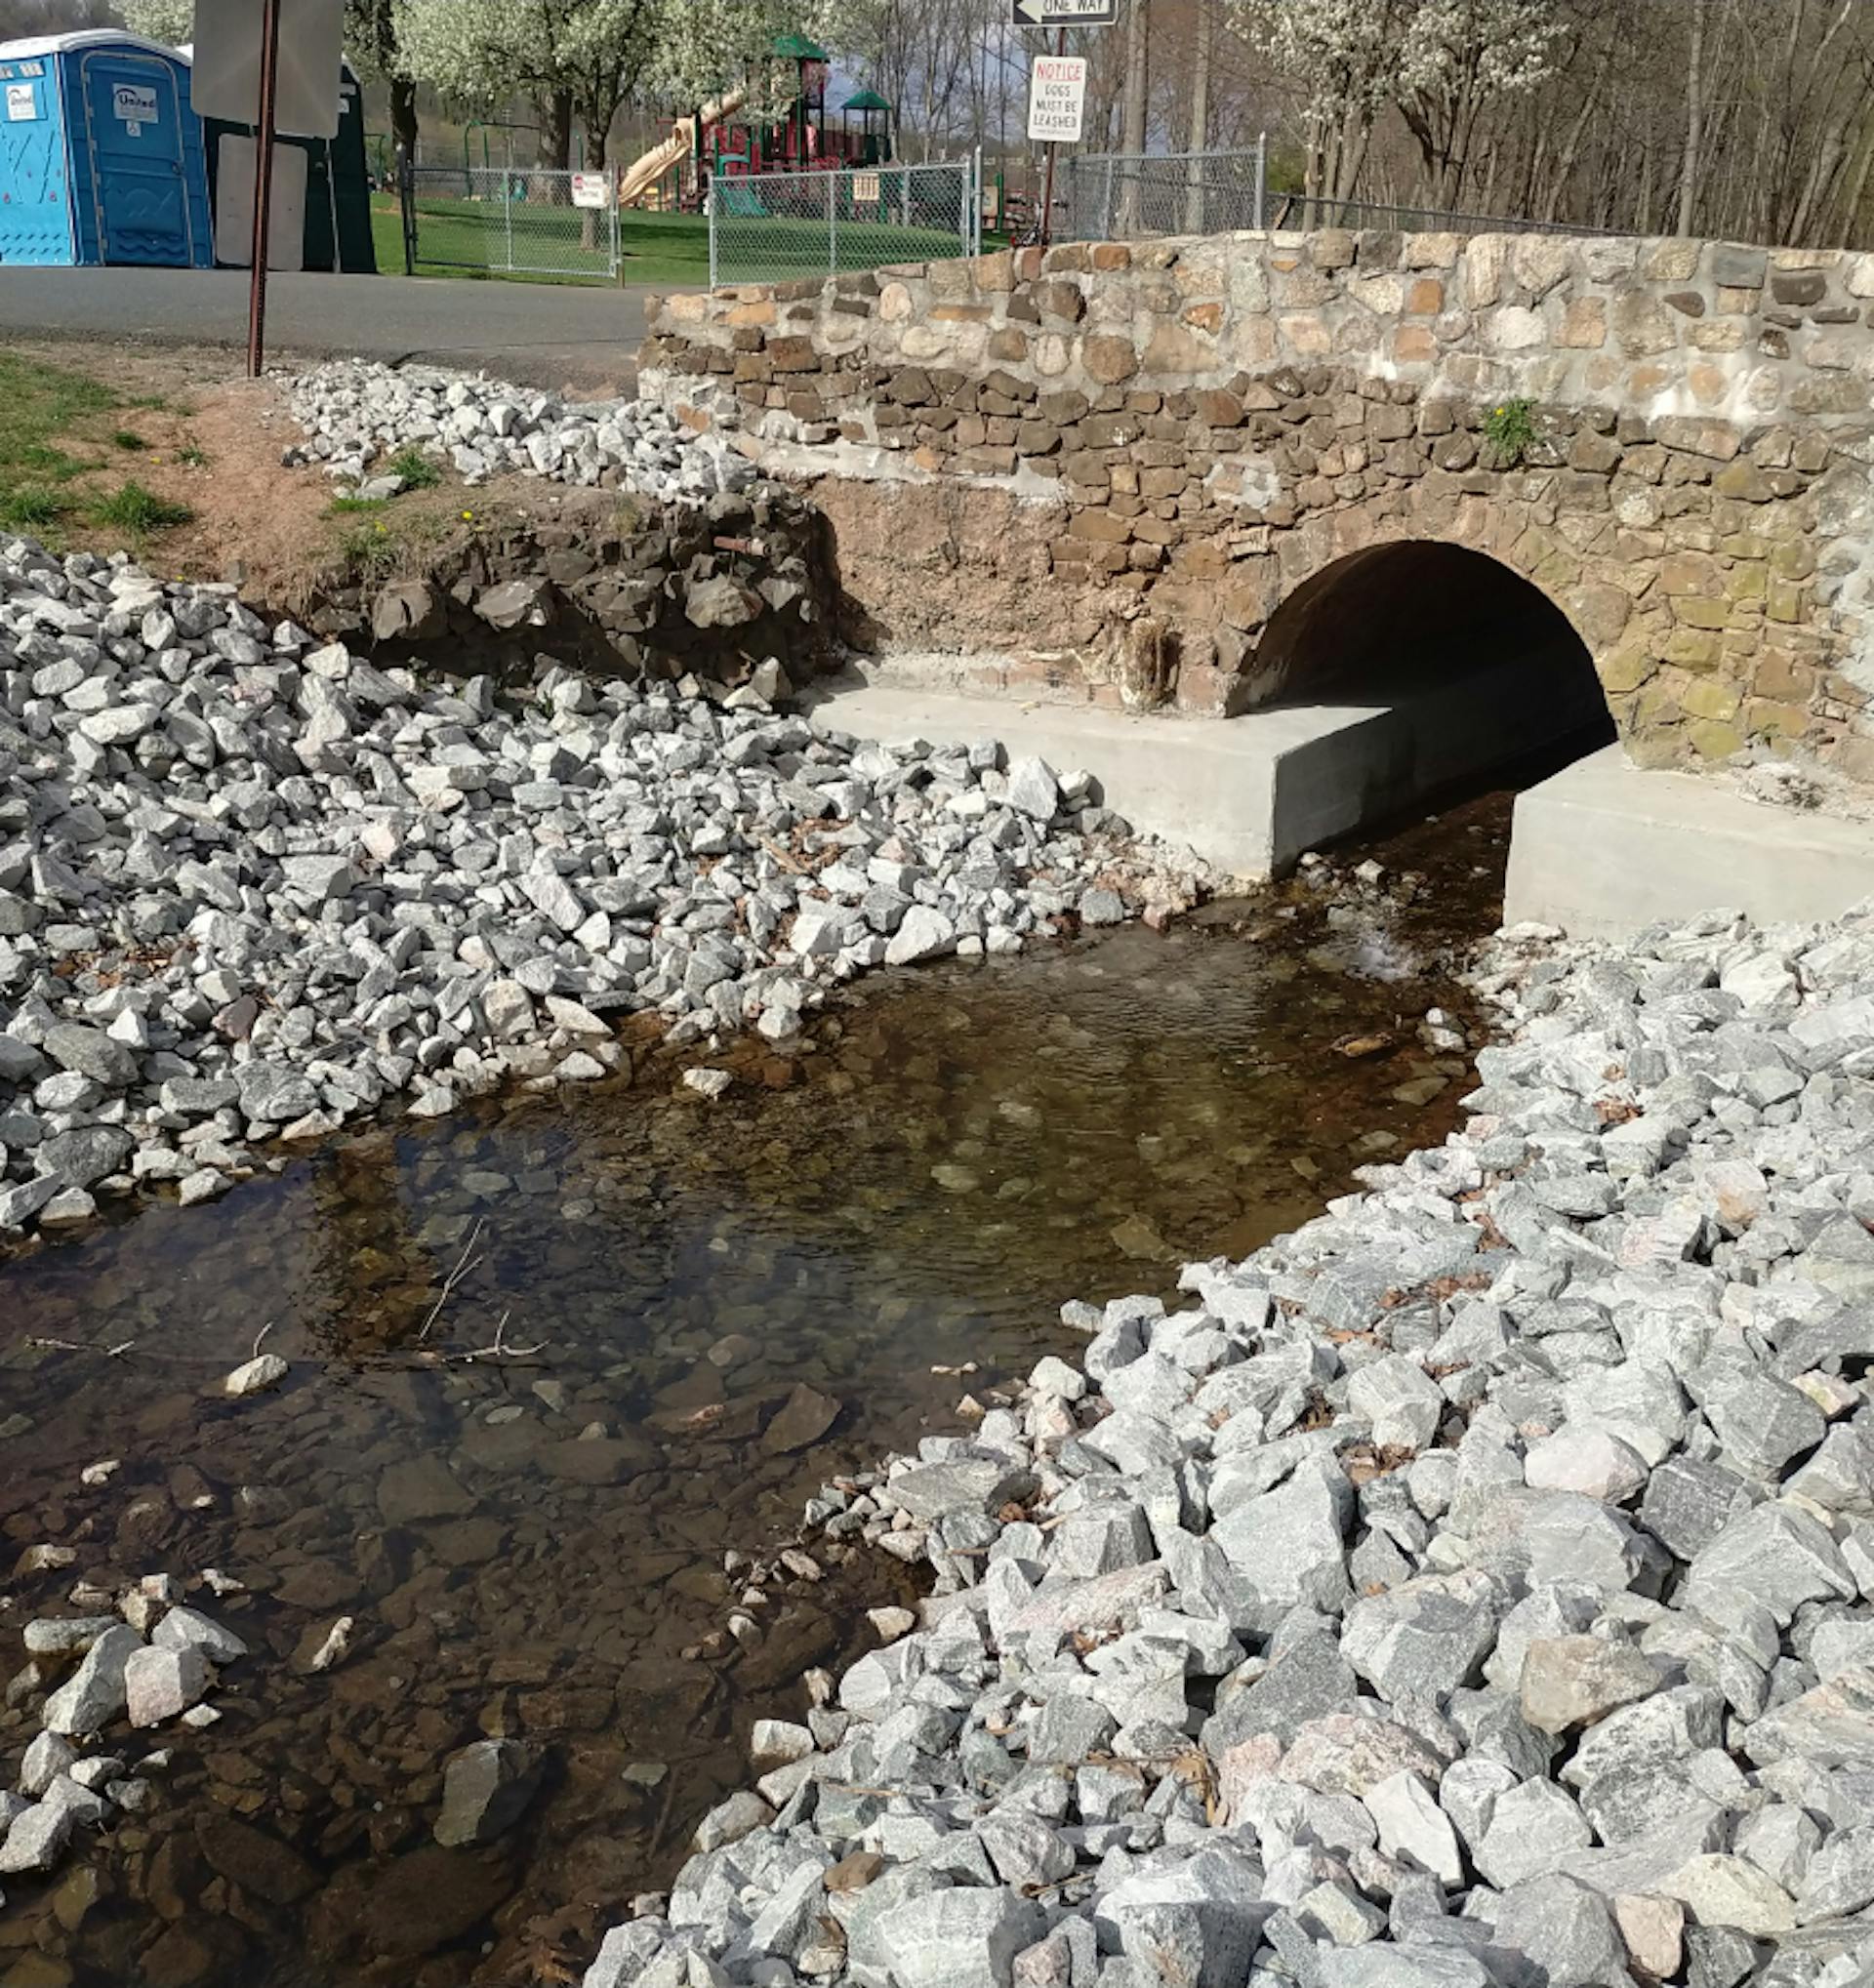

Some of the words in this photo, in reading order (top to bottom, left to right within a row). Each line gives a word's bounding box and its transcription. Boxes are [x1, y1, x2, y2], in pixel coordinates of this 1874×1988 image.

[1042, 0, 1072, 13] ONE
[1077, 0, 1103, 12] WAY
[1037, 62, 1081, 81] NOTICE
[1044, 85, 1071, 97] DOGS
[1036, 100, 1062, 111] MUST
[1065, 101, 1078, 112] BE
[1034, 114, 1077, 128] LEASHED
